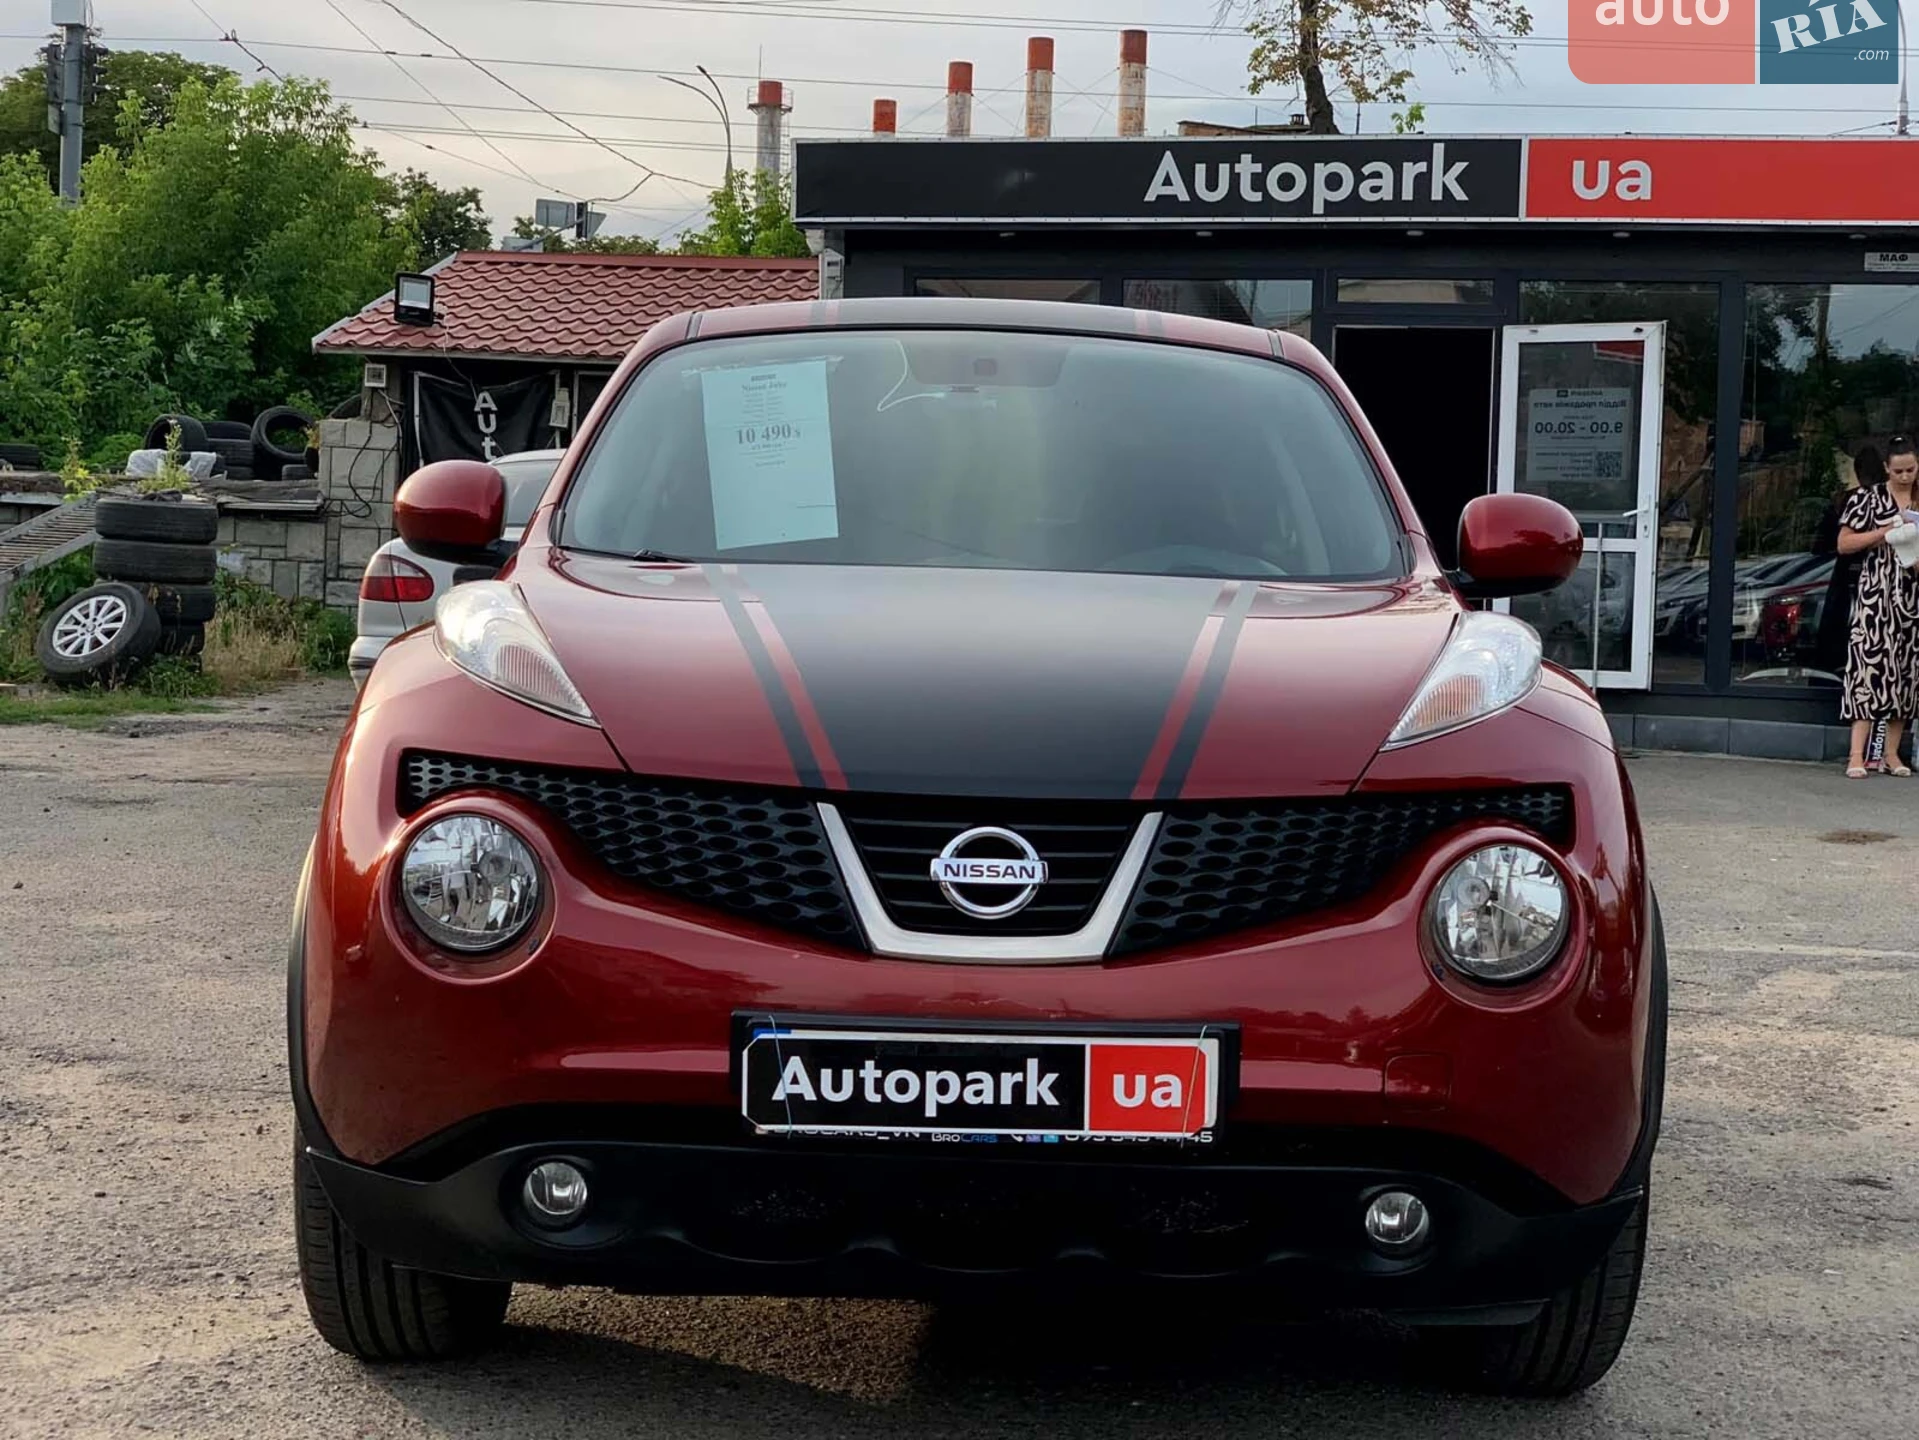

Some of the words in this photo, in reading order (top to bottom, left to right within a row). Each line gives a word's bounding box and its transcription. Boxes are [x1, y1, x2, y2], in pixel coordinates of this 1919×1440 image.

[1143, 142, 1469, 215] Autopark
[1571, 158, 1653, 201] ua
[736, 428, 756, 445] 10
[943, 863, 1036, 879] NISSAN
[771, 1055, 1060, 1118] Autopark
[1112, 1073, 1183, 1109] ua
